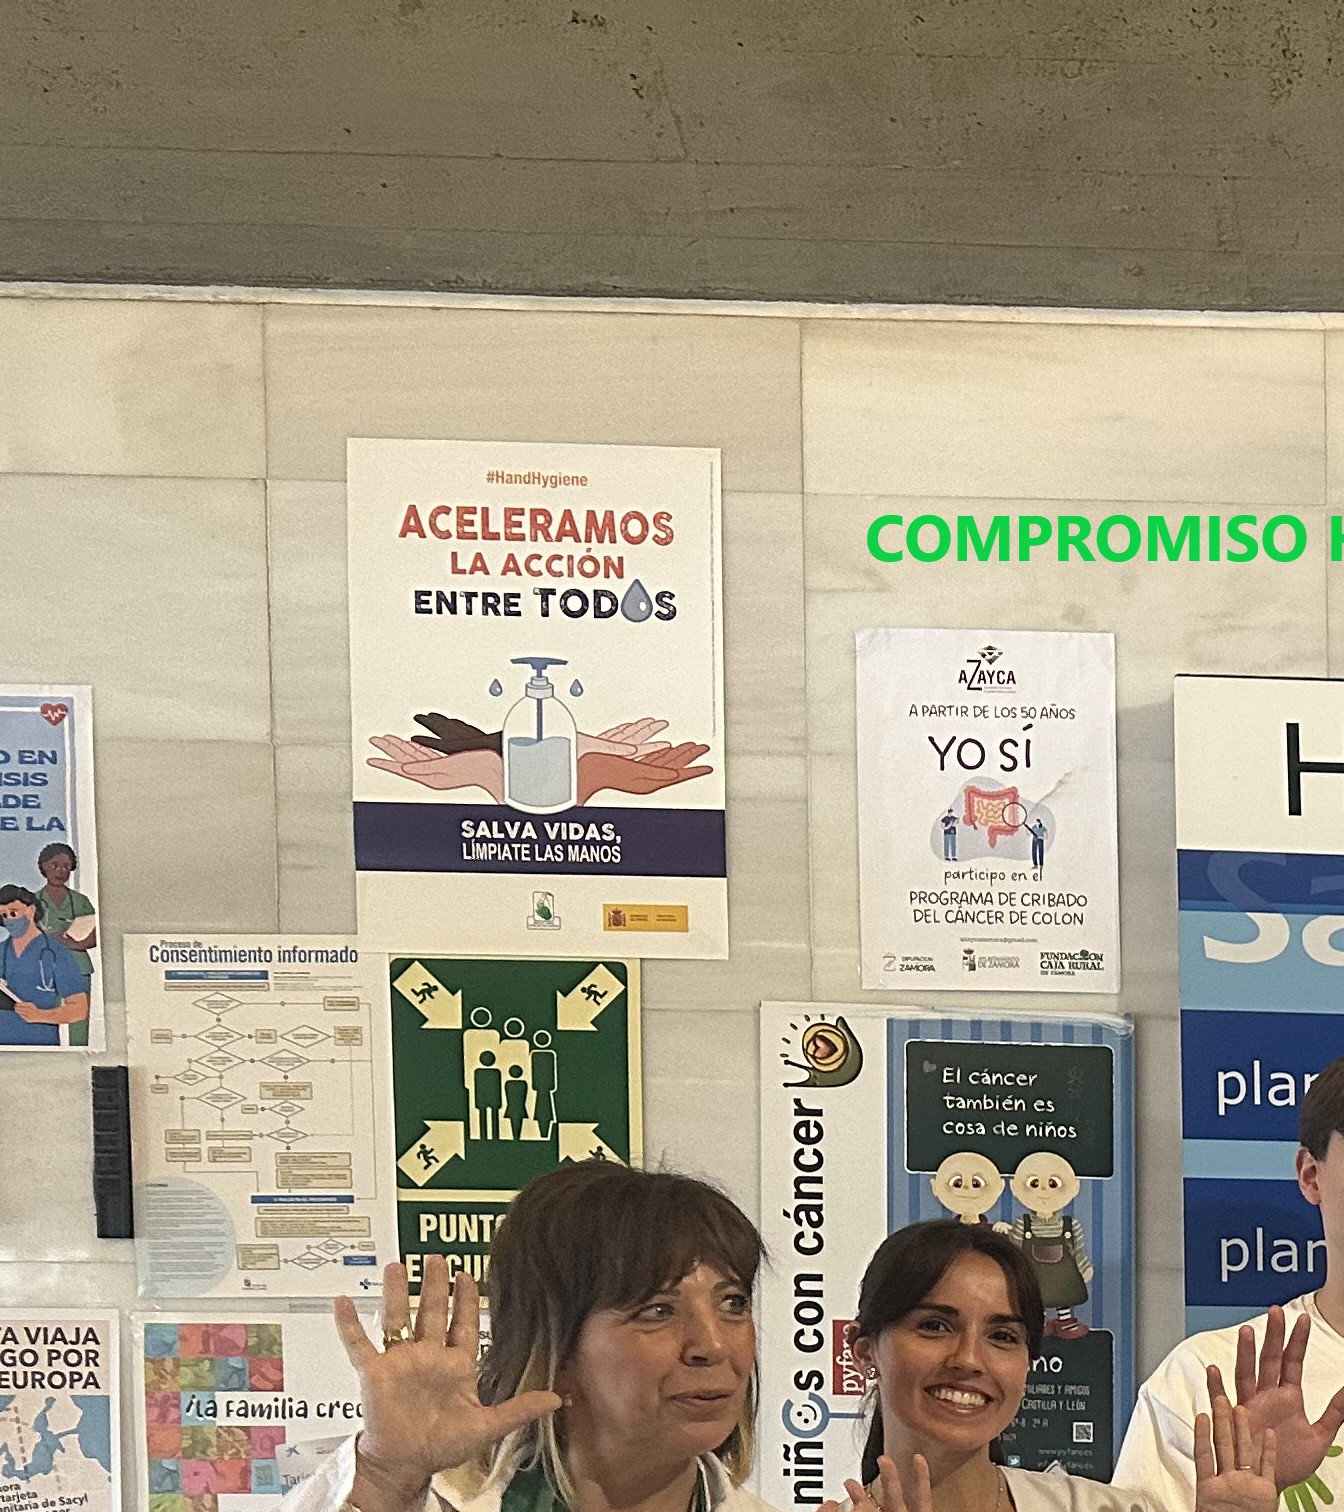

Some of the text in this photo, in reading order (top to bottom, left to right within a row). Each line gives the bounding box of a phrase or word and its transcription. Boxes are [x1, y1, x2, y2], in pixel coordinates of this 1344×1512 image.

[486, 470, 588, 488] #HandHygiene
[399, 504, 674, 546] ACELERAMOS
[451, 547, 624, 579] LA ACCIÓN
[414, 590, 522, 617] ENTRE
[958, 660, 1017, 691] AZAYCA
[922, 703, 1076, 720] PARTIR LOS AÑOS
[928, 723, 1033, 772] YO SÍ
[18, 750, 57, 765] EN
[26, 816, 66, 831] LA
[461, 820, 622, 843] SALVA VIDAS,
[535, 844, 564, 862] LAS
[568, 845, 621, 863] MANOS
[944, 868, 1006, 887] participo
[910, 891, 1088, 908] PROGRAMA CRIBADO
[913, 906, 1084, 926] DEL CÁNCER COLON
[150, 945, 358, 964] Consentimiento informado
[969, 1068, 1037, 1086] cáncer
[943, 1092, 1025, 1111] también
[943, 1121, 1077, 1138] cosa niños
[783, 1098, 824, 1353] con cáncer
[24, 1327, 100, 1345] VIAJA
[47, 1349, 100, 1367] POR
[0, 1371, 100, 1389] EUROPA
